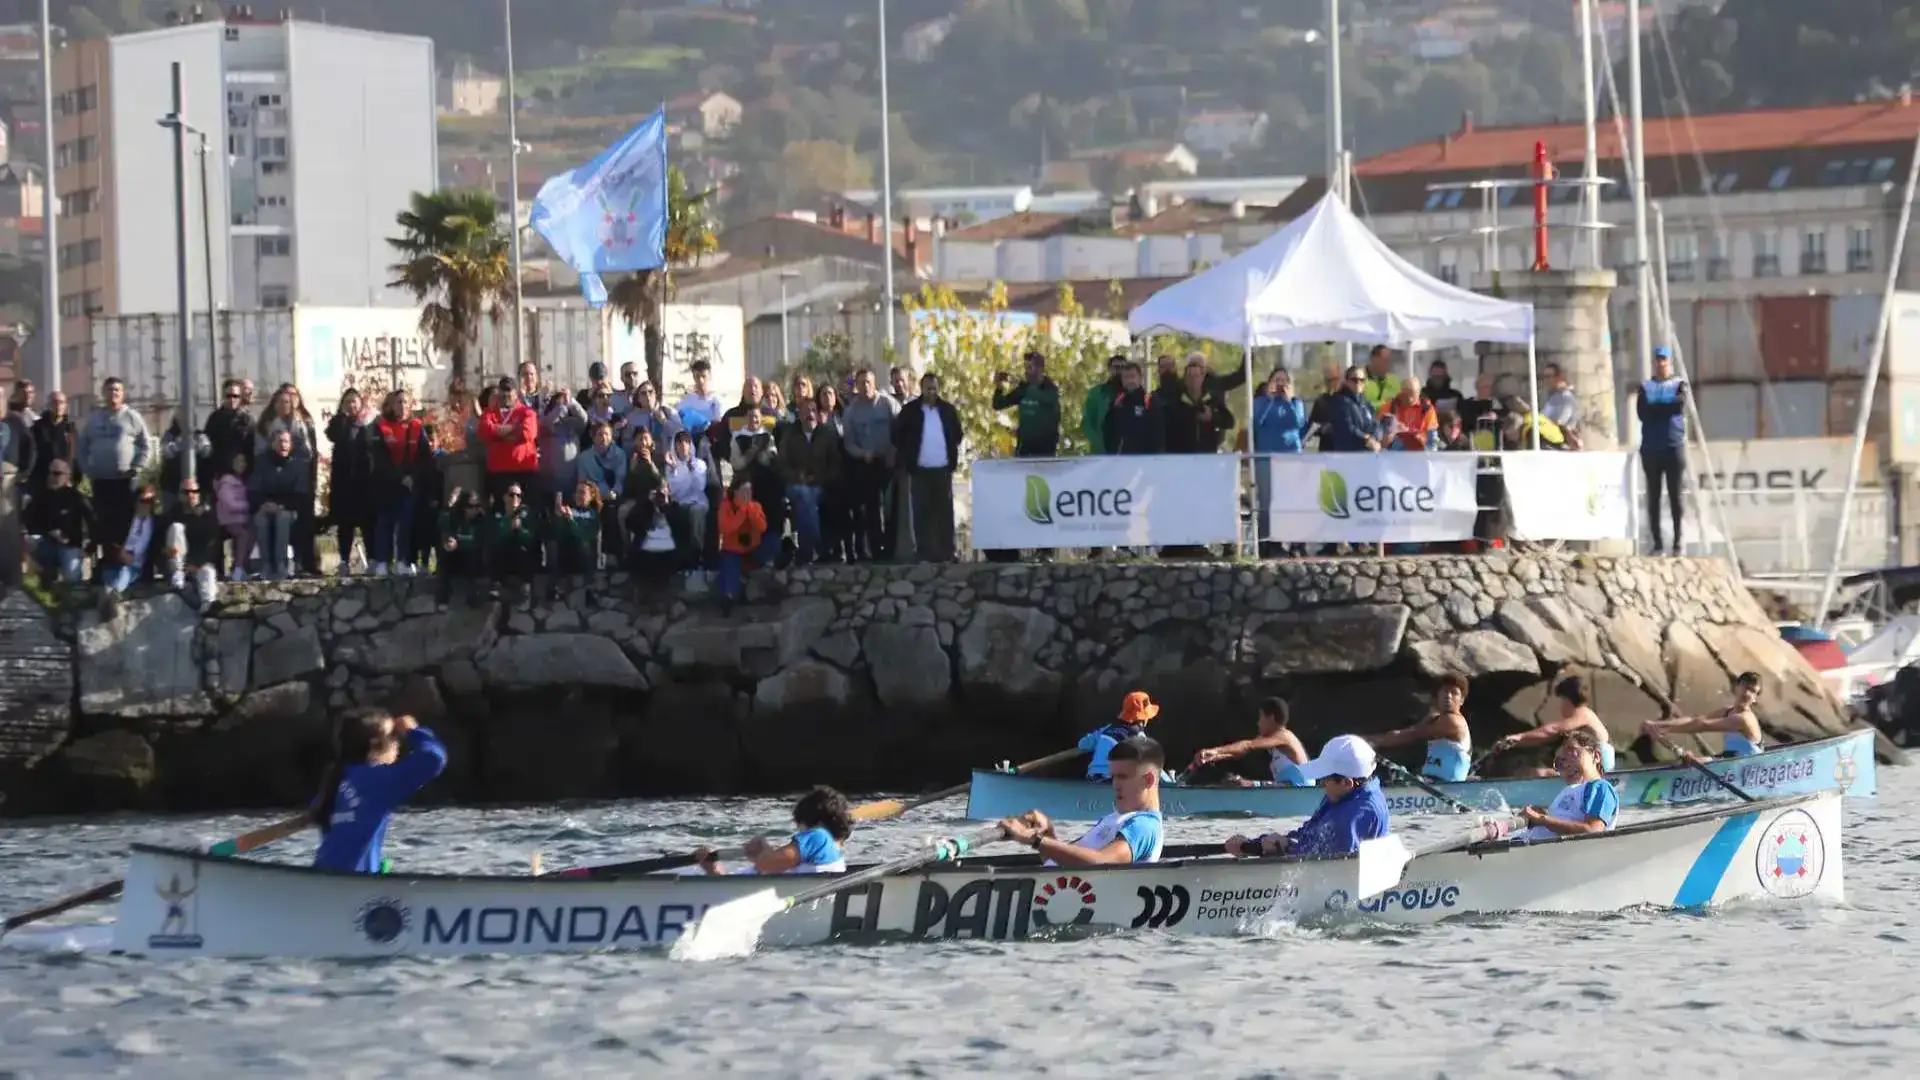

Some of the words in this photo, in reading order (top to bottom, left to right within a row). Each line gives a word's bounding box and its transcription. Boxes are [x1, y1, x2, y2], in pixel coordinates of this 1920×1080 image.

[1056, 489, 1132, 517] ence
[1355, 486, 1434, 513] ence
[1671, 775, 1712, 798] Porto
